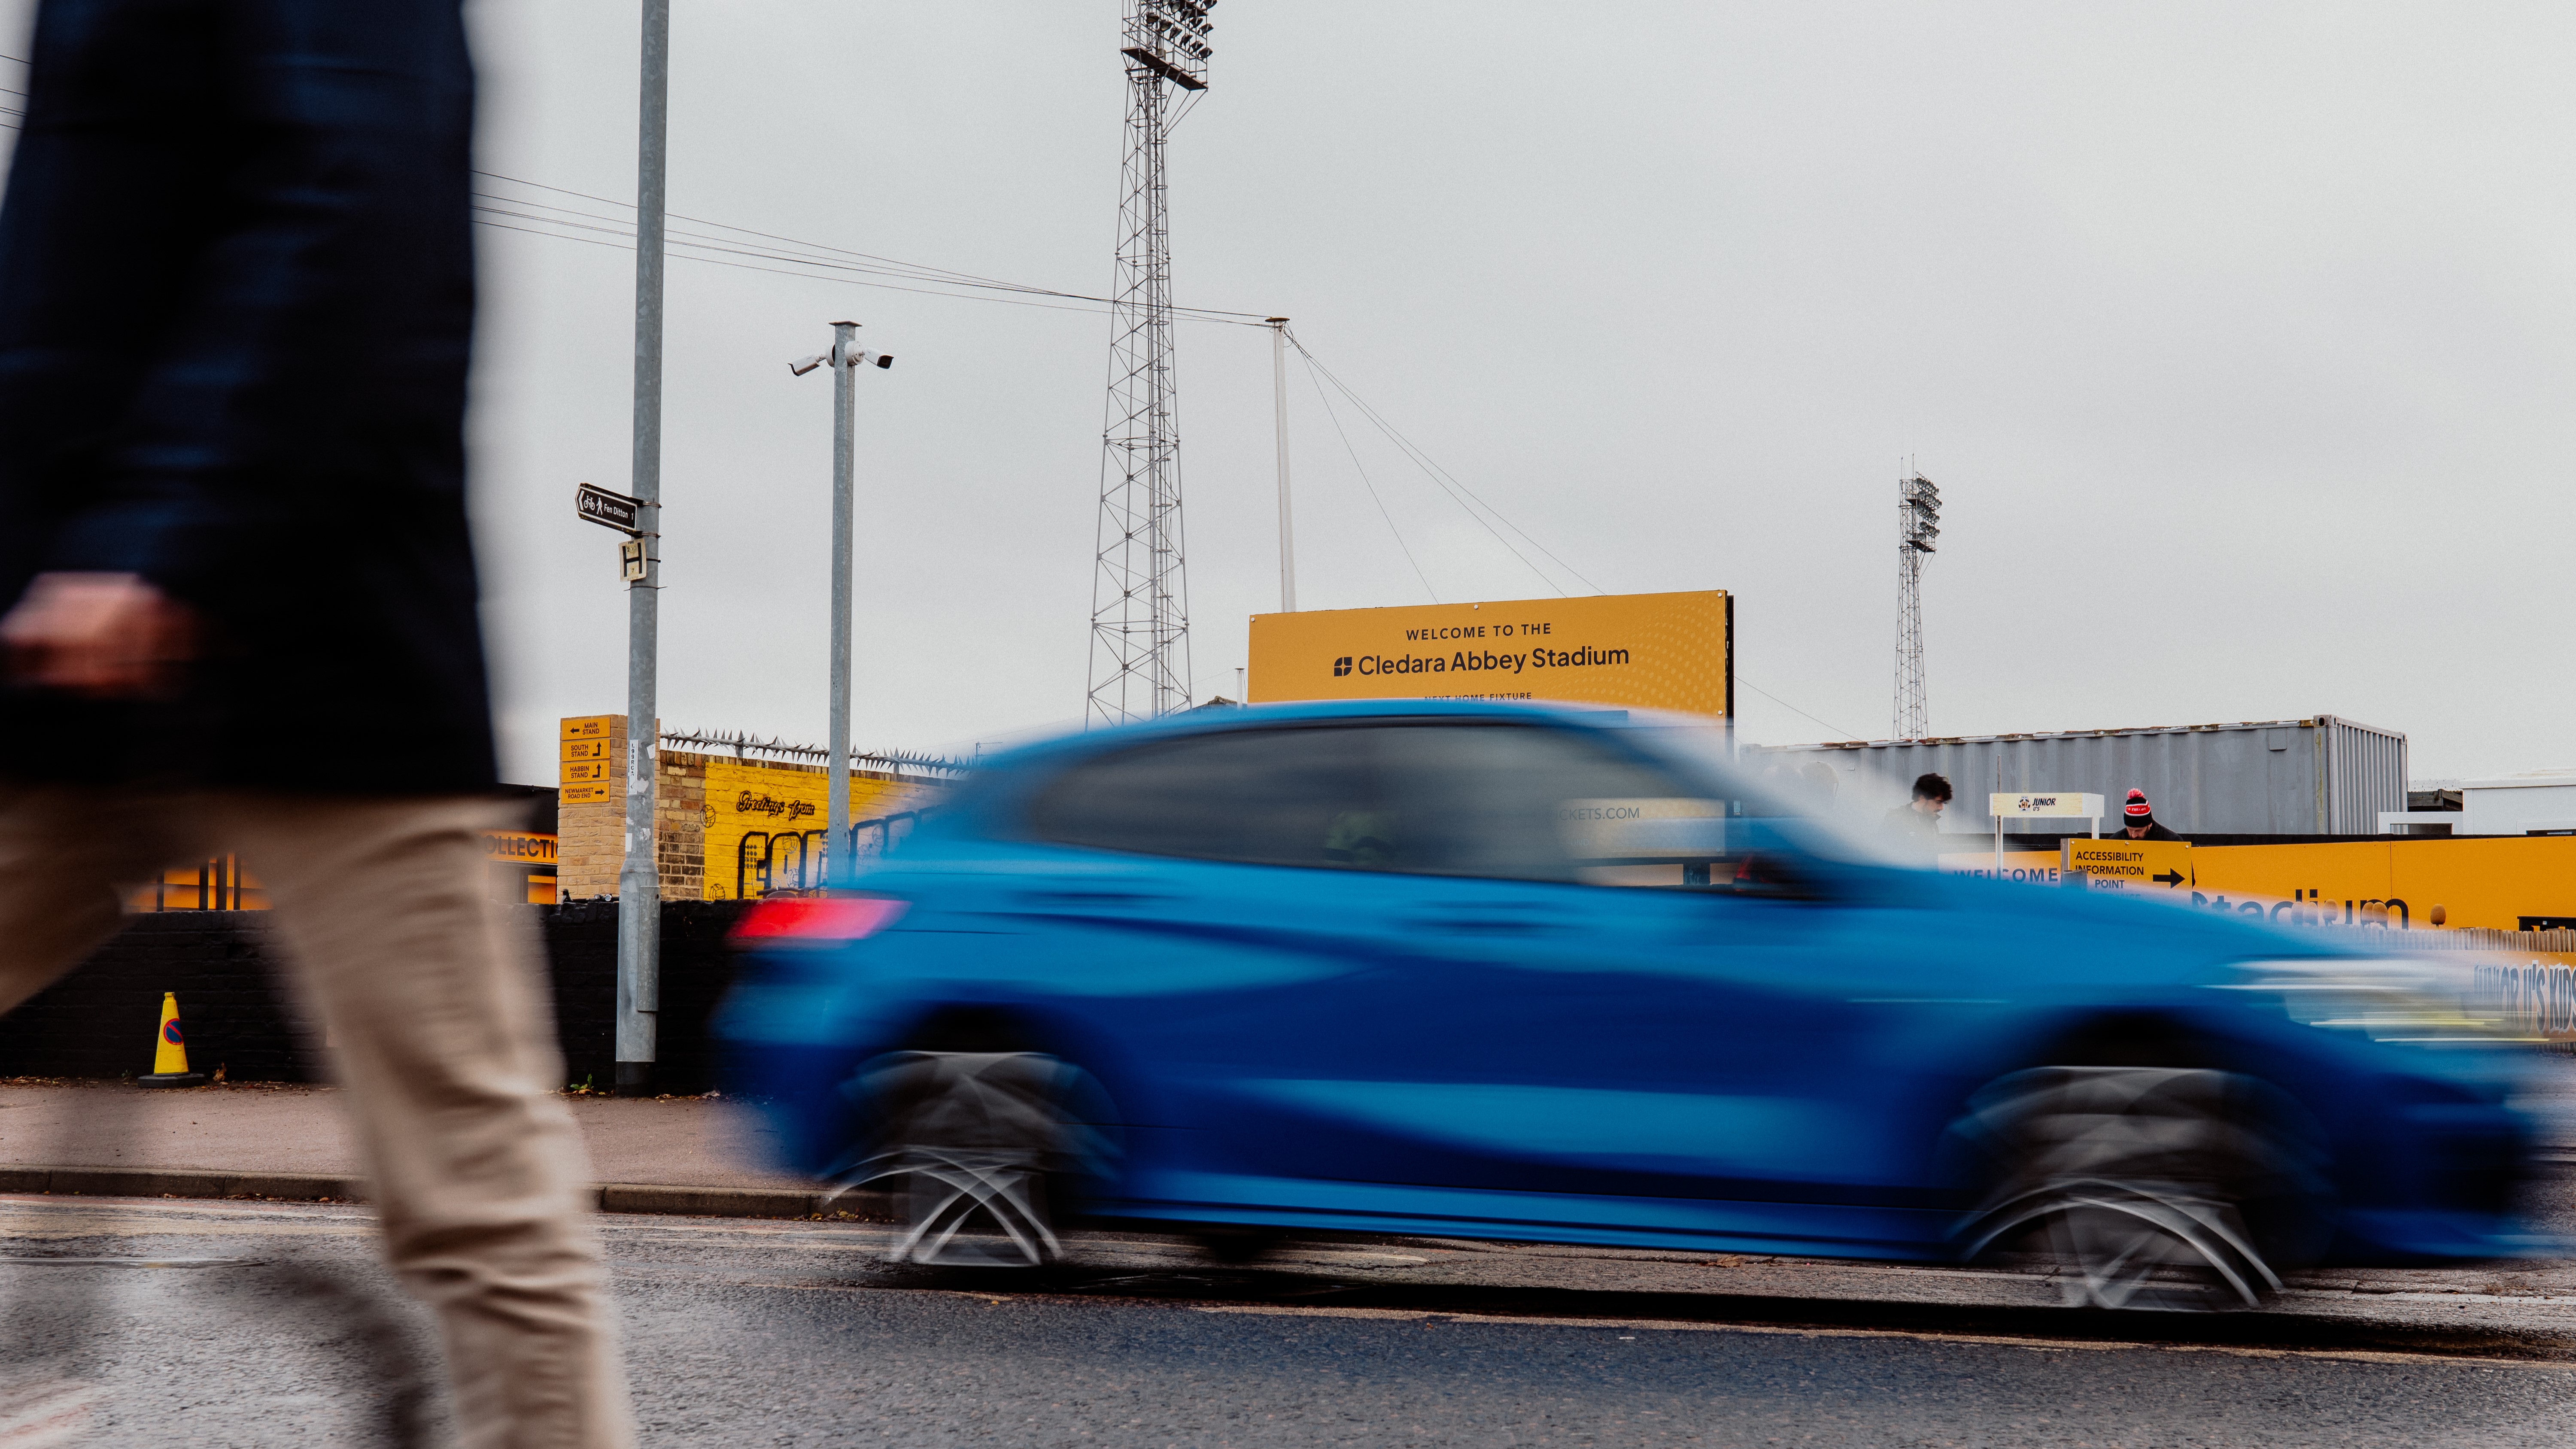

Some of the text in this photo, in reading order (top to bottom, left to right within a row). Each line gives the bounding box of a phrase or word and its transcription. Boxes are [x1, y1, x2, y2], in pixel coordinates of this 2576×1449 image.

[604, 503, 612, 513] Fen
[614, 507, 628, 519] Ditton
[622, 542, 642, 577] H
[1406, 623, 1551, 641] WELCOME TO THE
[1358, 646, 1629, 675] Cledara Abbey Stadium
[1455, 694, 1485, 702] HOME
[1490, 692, 1531, 701] FIXTURE
[736, 790, 815, 821] Greetings from
[2032, 798, 2056, 806] JUNIOR
[1558, 807, 1640, 820] CKETS.COM
[485, 834, 558, 858] OLLECTI
[2075, 851, 2144, 862] ACCESSIBILITY
[2095, 879, 2125, 889] POINT
[2523, 960, 2546, 1035] U'S
